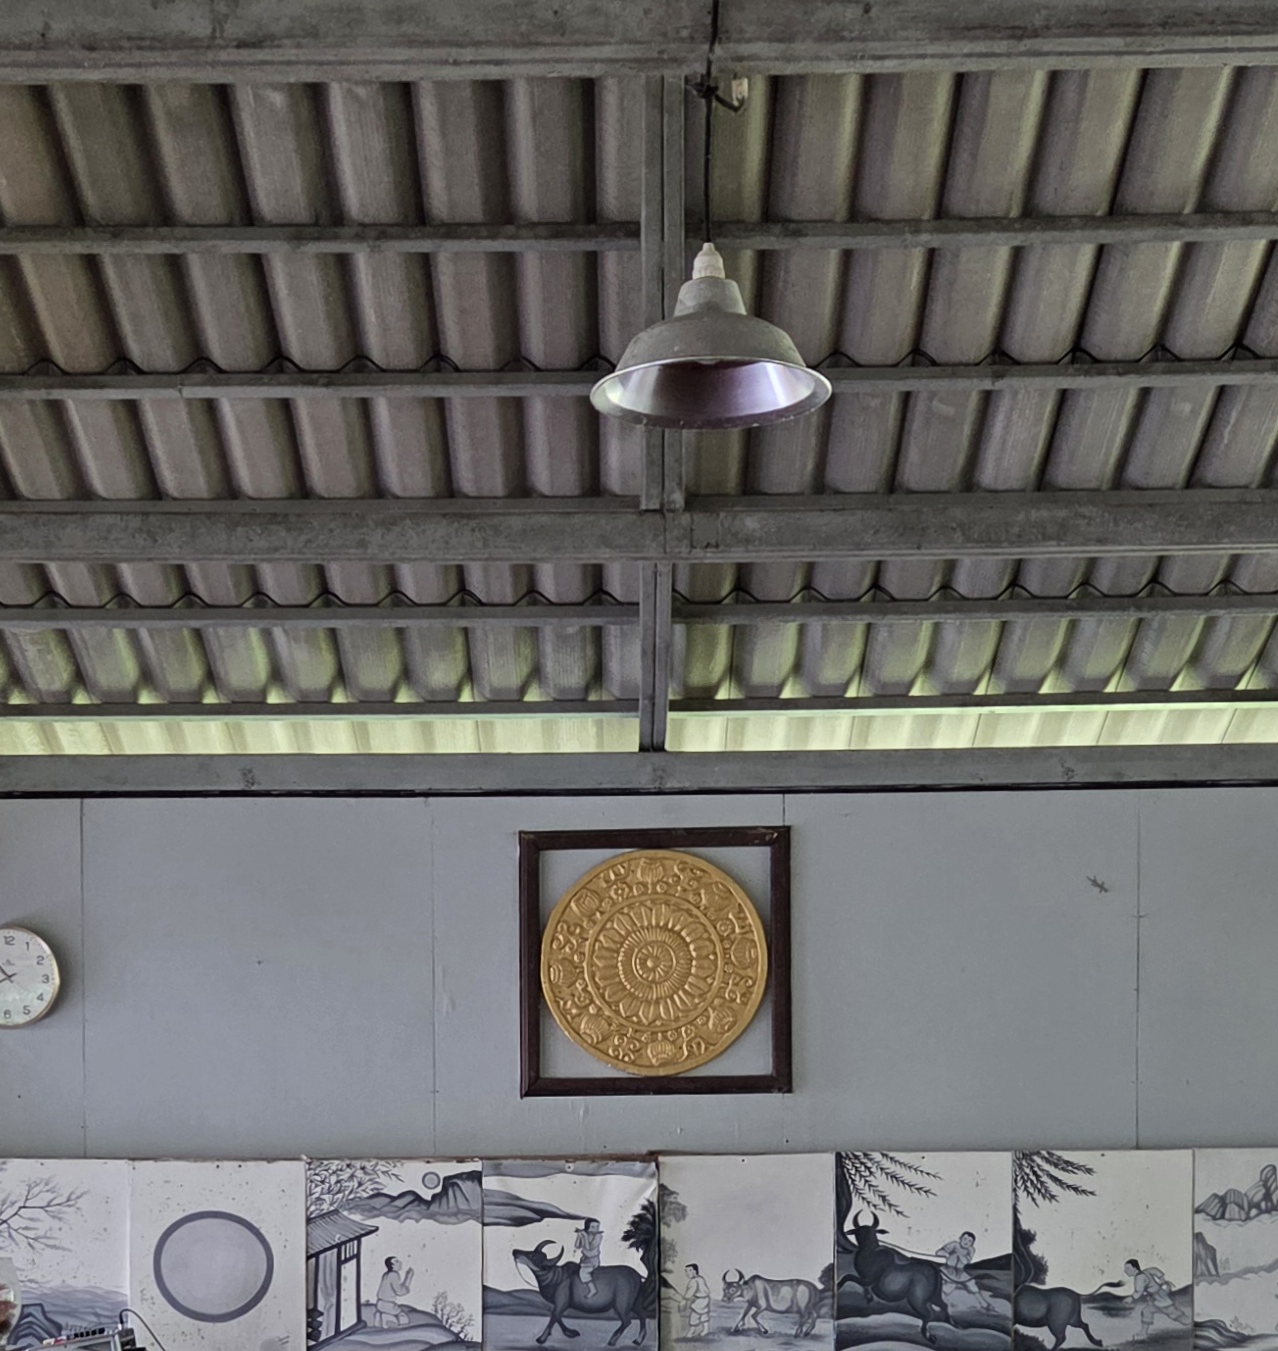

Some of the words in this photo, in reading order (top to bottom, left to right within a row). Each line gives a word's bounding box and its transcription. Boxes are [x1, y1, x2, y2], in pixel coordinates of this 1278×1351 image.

[3, 935, 15, 946] 12
[25, 941, 30, 951] 1
[36, 955, 45, 966] 2
[42, 974, 50, 984] 3
[36, 992, 44, 1002] 4
[3, 1009, 11, 1019] 6
[23, 1005, 31, 1015] 5
